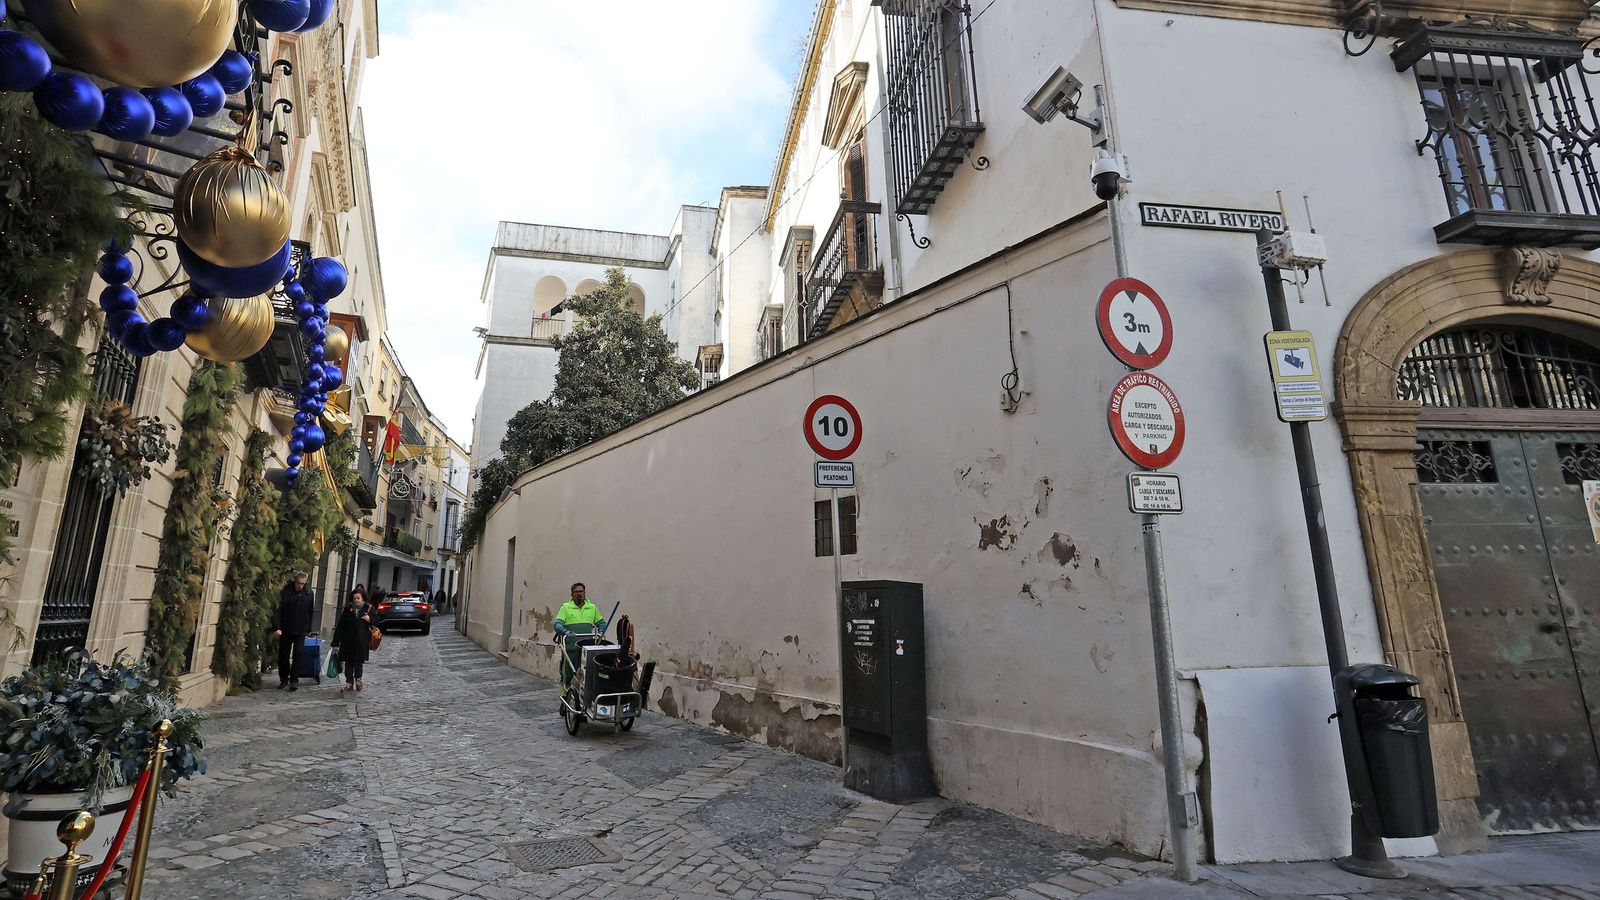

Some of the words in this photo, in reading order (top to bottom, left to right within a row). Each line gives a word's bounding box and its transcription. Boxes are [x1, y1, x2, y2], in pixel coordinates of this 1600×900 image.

[1146, 207, 1216, 225] RAFAEL
[1219, 212, 1281, 229] RIVERO
[1117, 384, 1127, 396] DE
[1148, 376, 1180, 413] RESTRINGIDO
[1134, 402, 1157, 410] EXCEPTO
[818, 415, 849, 437] 10
[1124, 421, 1142, 429] CARGA
[1147, 423, 1173, 431] DESCARGA
[818, 464, 852, 472] PREFERENCIA
